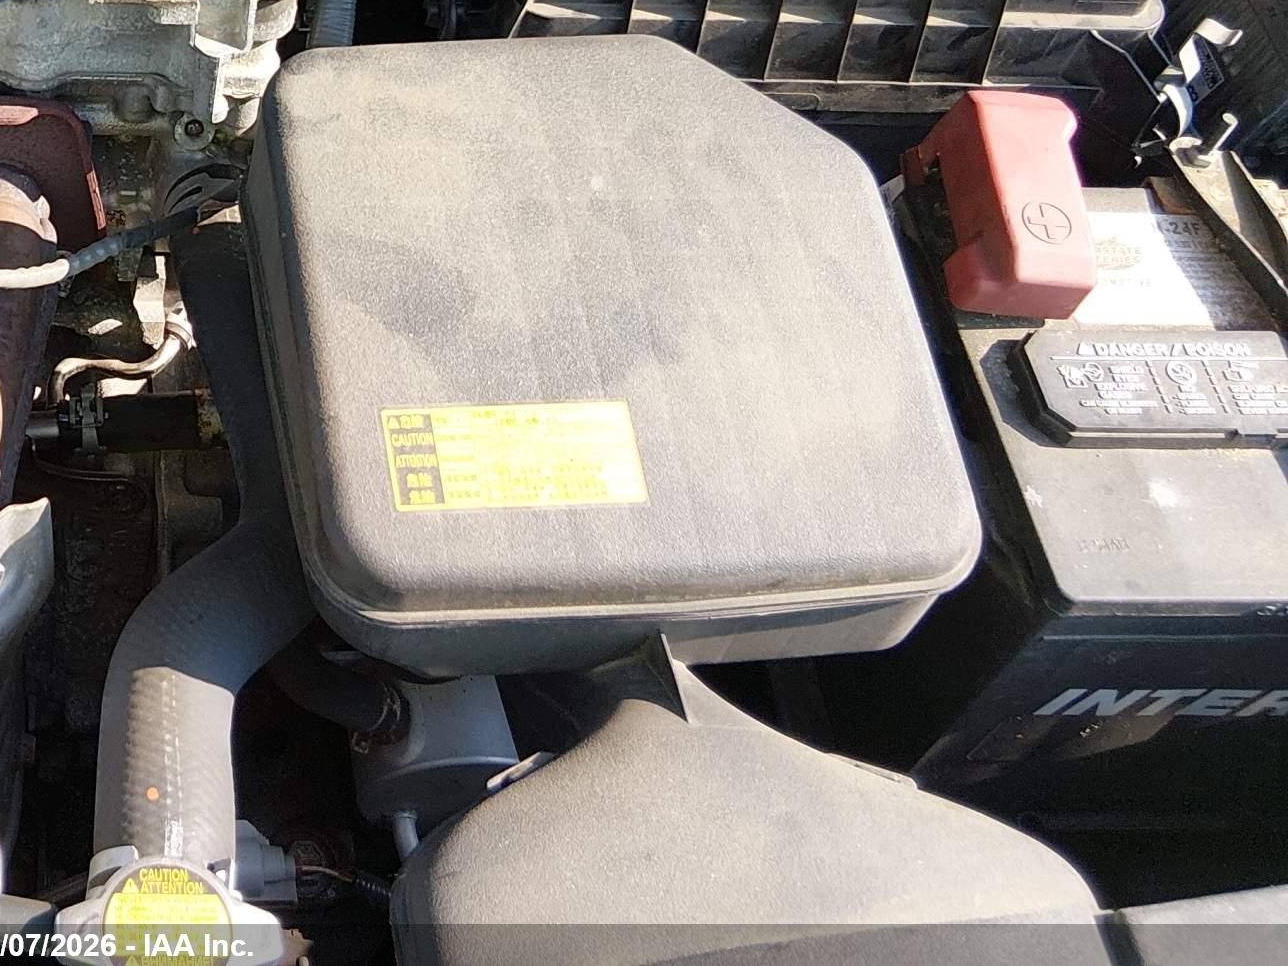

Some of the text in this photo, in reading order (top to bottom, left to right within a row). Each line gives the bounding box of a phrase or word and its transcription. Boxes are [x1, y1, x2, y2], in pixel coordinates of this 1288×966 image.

[391, 433, 433, 447] CAUTION
[139, 869, 189, 882] CAUTION
[140, 881, 204, 894] ATTENTION
